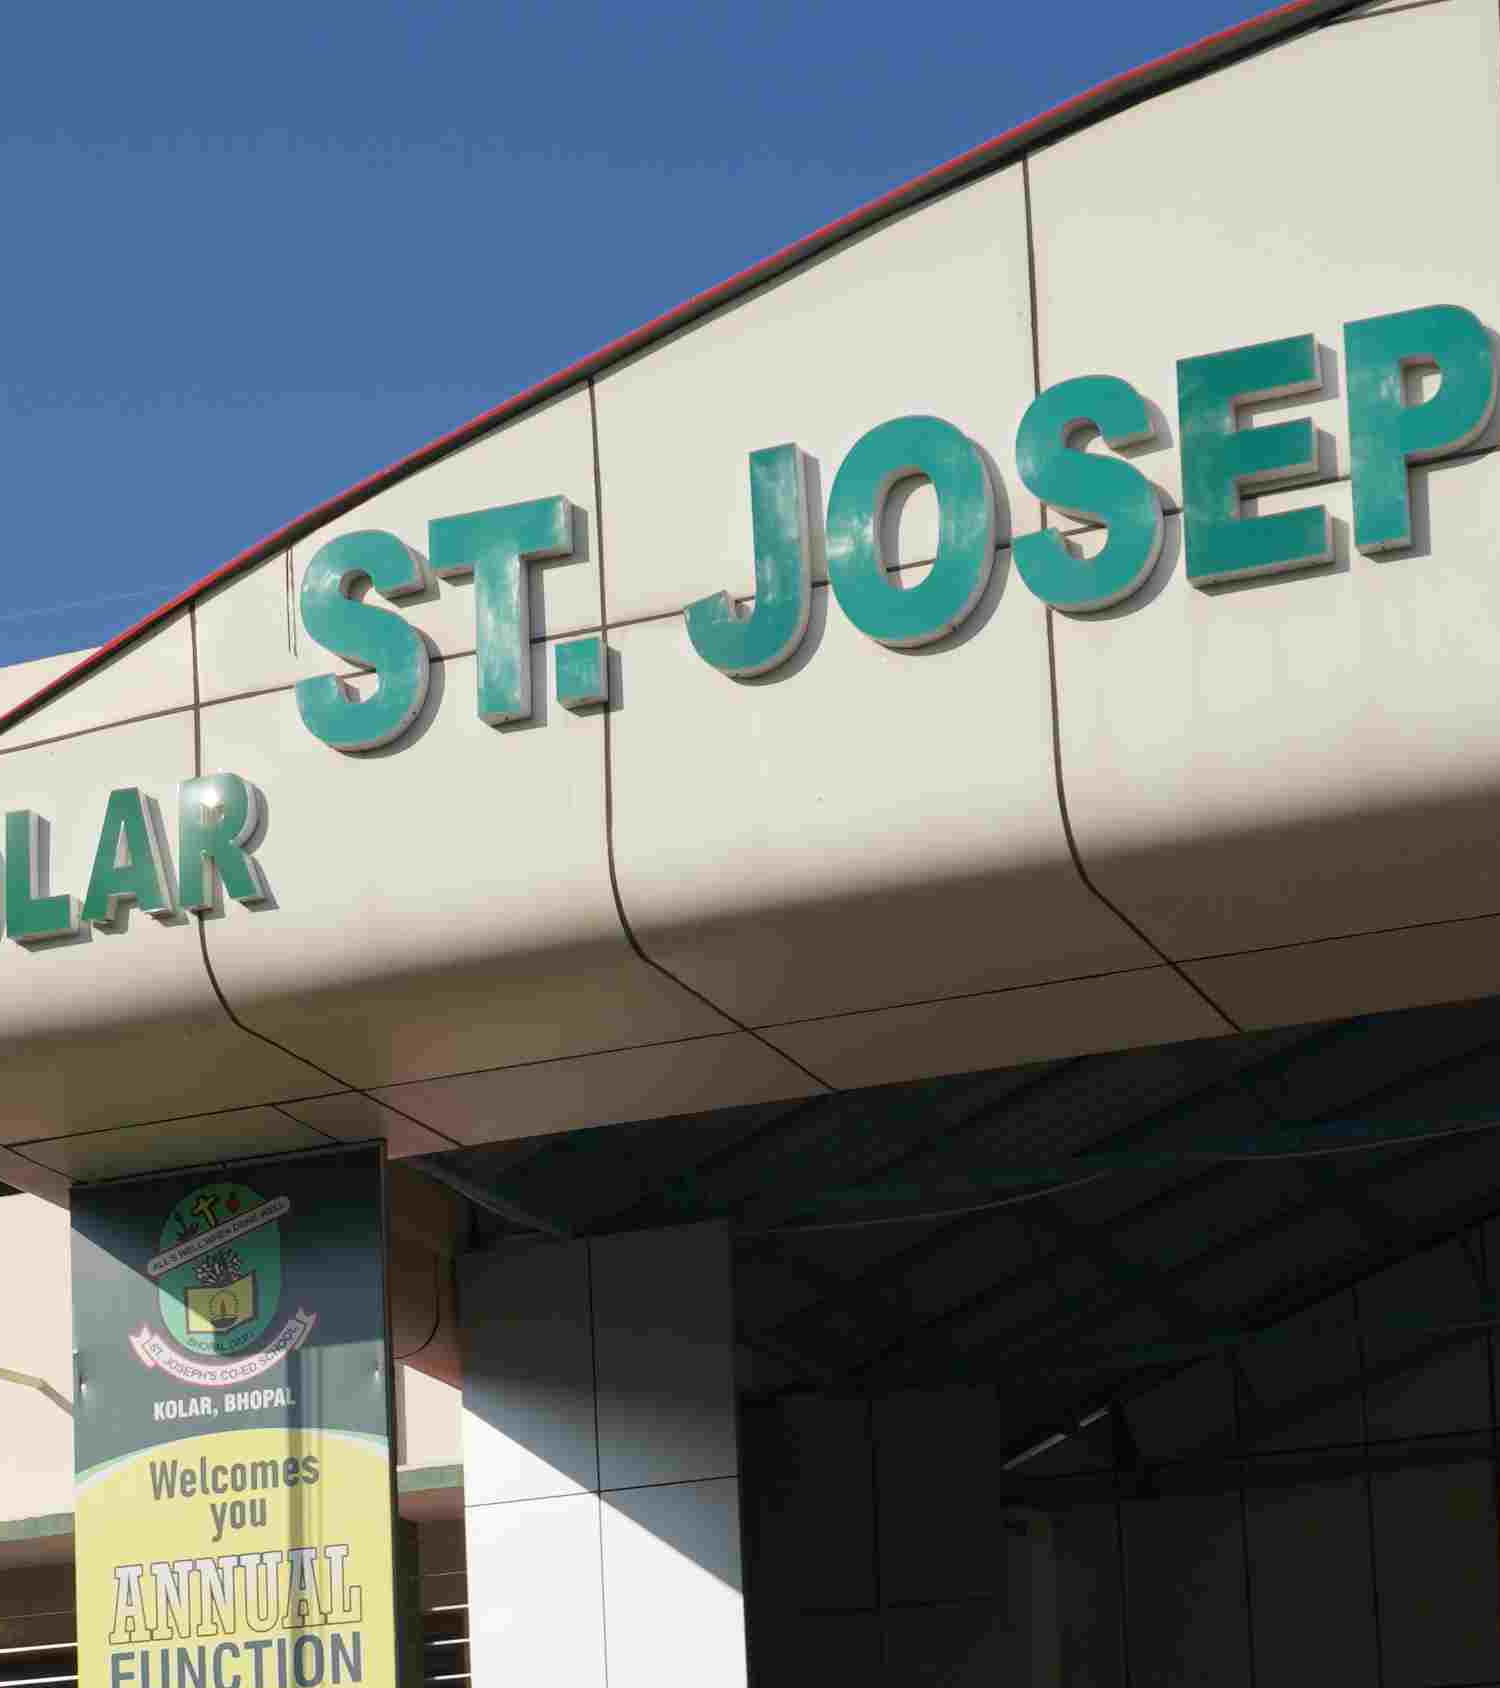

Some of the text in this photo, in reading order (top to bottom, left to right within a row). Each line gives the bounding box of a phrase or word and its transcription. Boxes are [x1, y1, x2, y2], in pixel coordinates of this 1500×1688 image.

[295, 493, 608, 753] ST.
[153, 1386, 297, 1422] KOLAR, BHOPAL
[150, 1454, 321, 1500] Welcomes
[210, 1498, 267, 1543] you
[109, 1544, 363, 1645] ANNUAL
